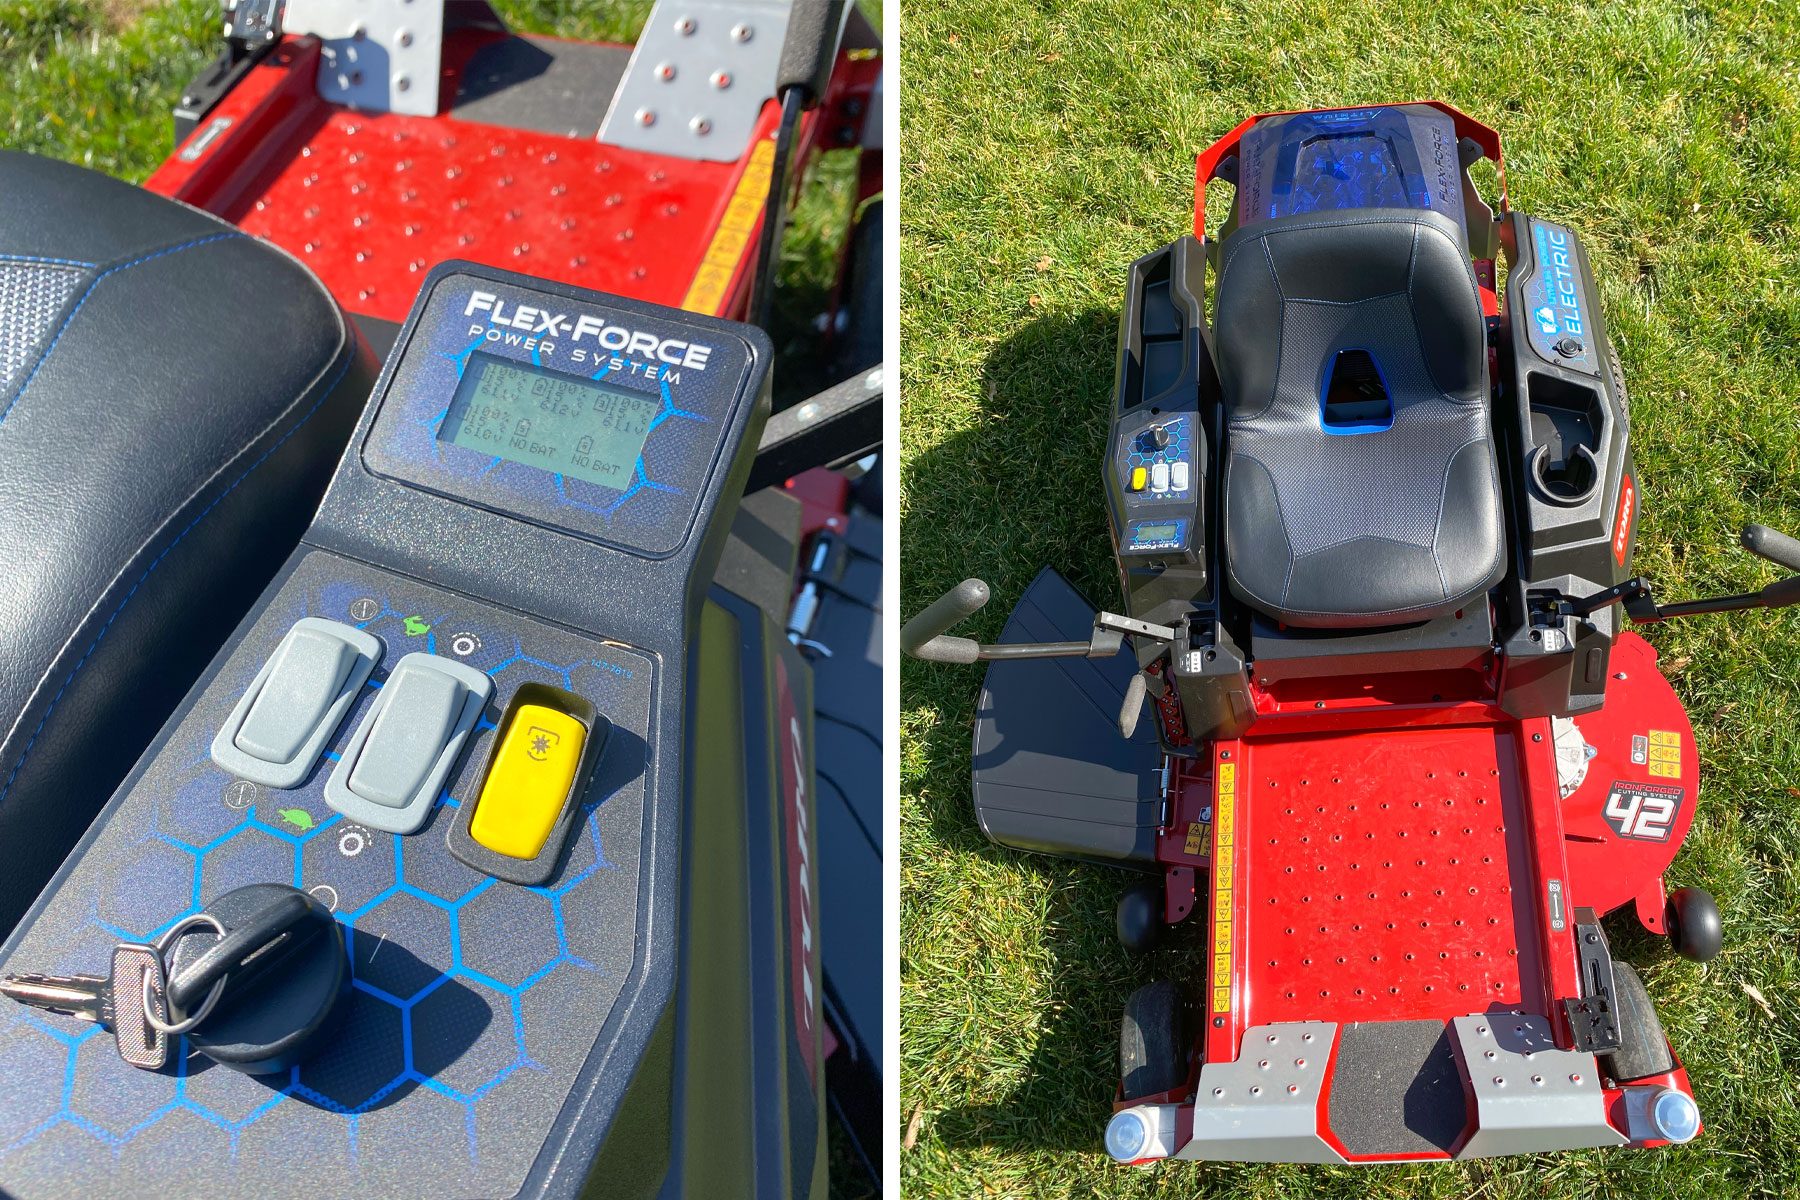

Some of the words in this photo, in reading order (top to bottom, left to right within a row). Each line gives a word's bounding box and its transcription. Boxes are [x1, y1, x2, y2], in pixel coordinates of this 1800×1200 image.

[1432, 126, 1449, 203] FLEX-FORCE
[1549, 231, 1581, 334] ELECTRIC
[464, 291, 712, 371] FLEX-FORCE
[468, 325, 555, 356] POWER
[571, 350, 681, 385] SYSTEM
[509, 436, 527, 449] NO
[529, 442, 557, 457] BAT
[570, 454, 589, 468] NO
[592, 459, 620, 475] BAT
[1616, 487, 1633, 552] TORO
[1606, 793, 1675, 838] 42
[1614, 781, 1681, 795] IRONFORGED
[1618, 789, 1648, 797] CUTTING
[1650, 792, 1678, 800] SYSTEM
[790, 716, 814, 1031] TORO
